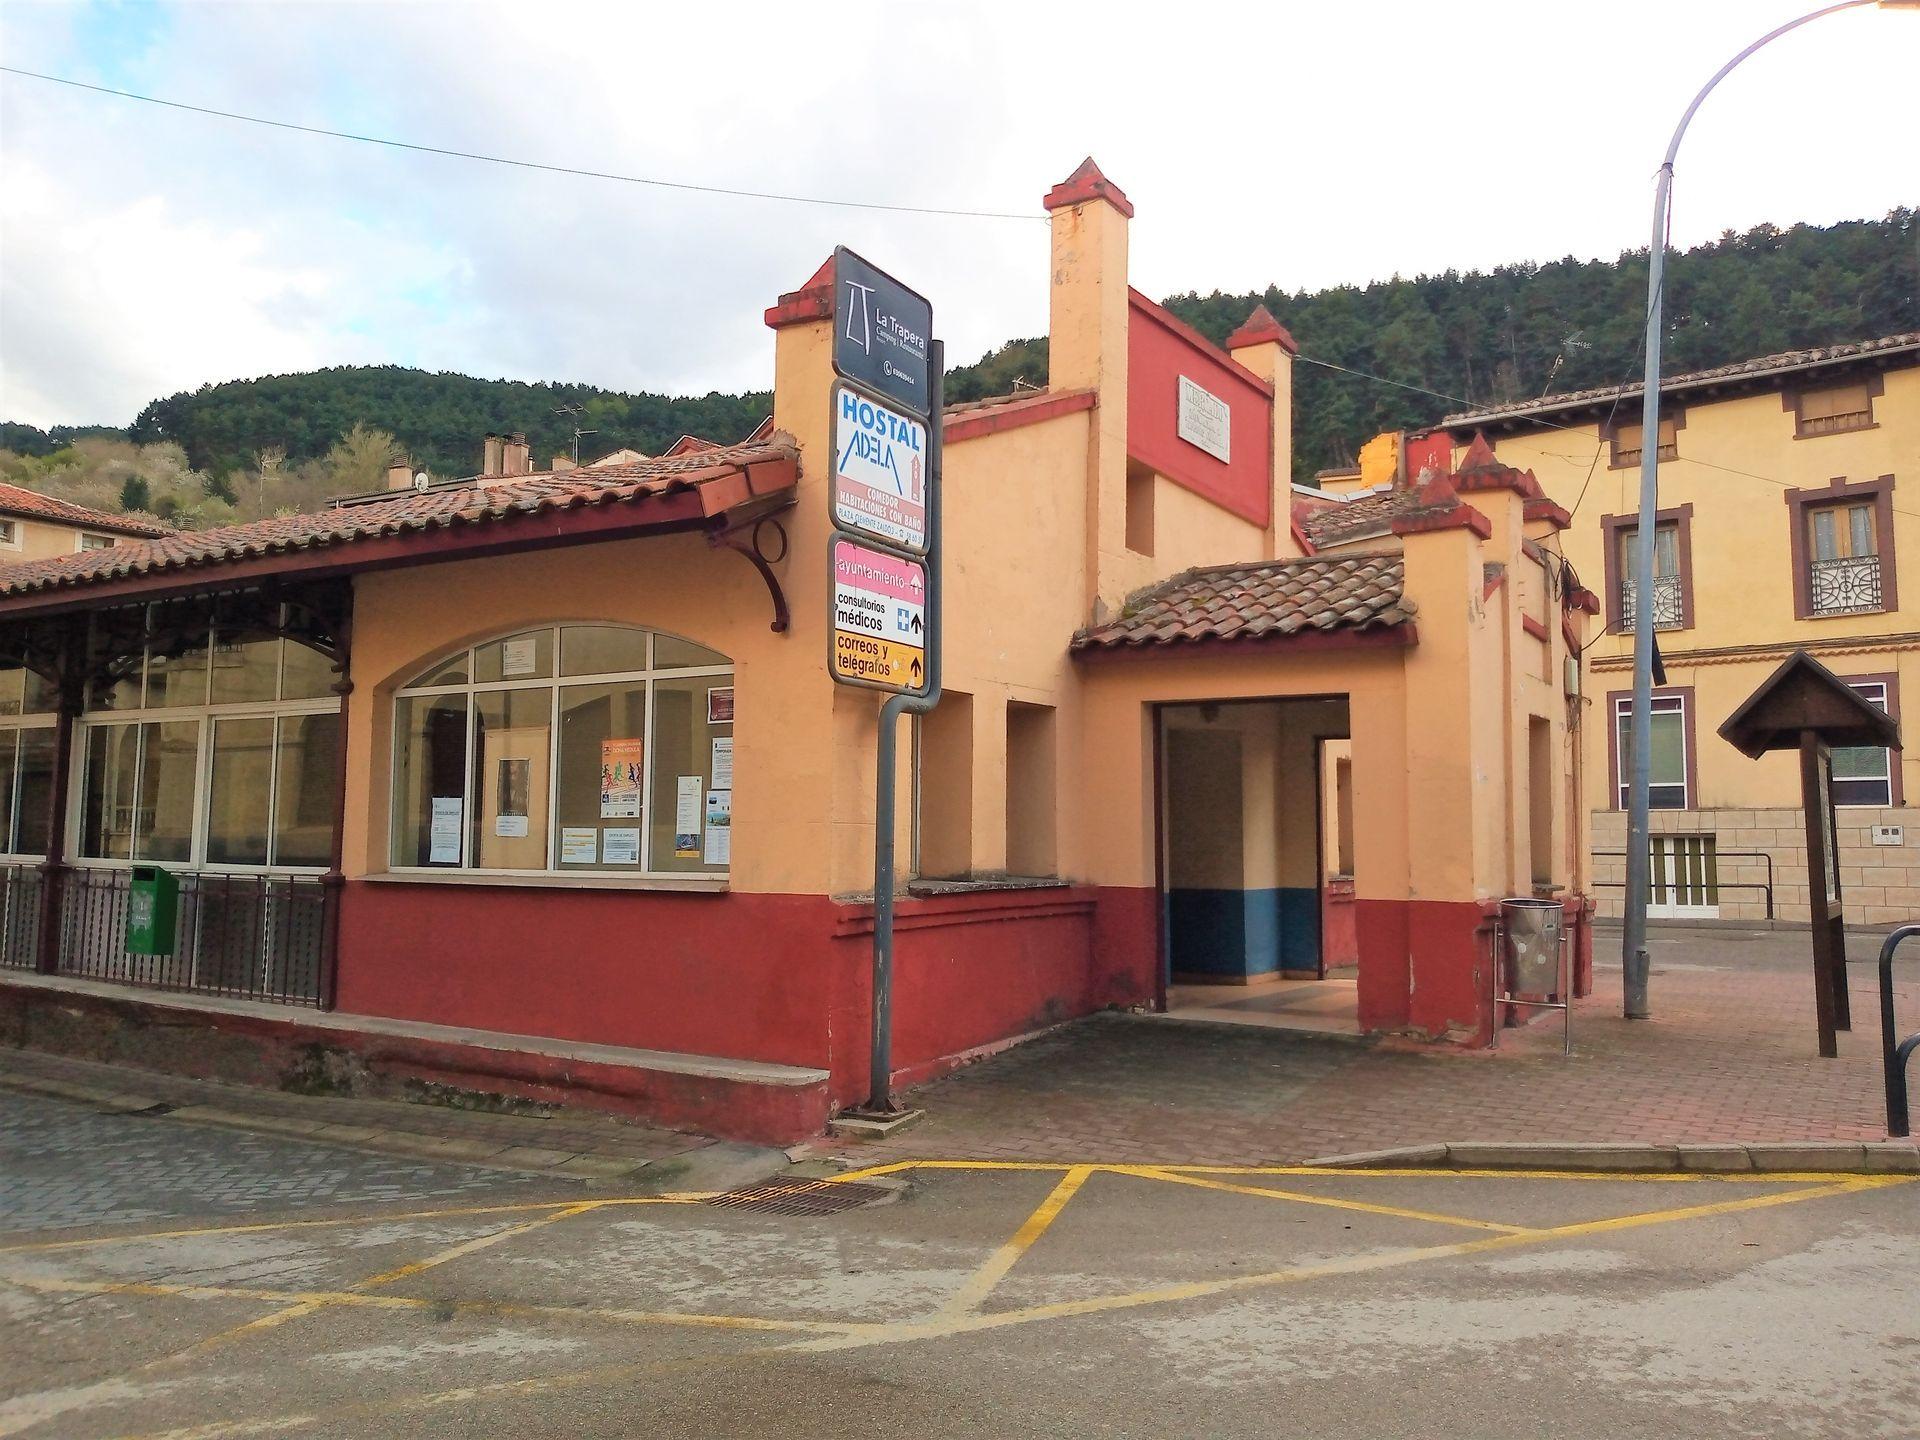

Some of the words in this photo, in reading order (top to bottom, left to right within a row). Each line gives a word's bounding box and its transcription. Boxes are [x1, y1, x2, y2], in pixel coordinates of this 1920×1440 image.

[876, 308, 887, 328] La
[889, 316, 924, 350] Trapera
[843, 394, 920, 453] HOSTAL
[839, 429, 903, 496] ADELA
[839, 490, 887, 518] HABITACIONES
[889, 509, 902, 524] CON
[904, 514, 922, 531] BAÑO
[867, 488, 899, 509] COMEDOR
[838, 507, 853, 520] PLAZA
[854, 513, 876, 529] CLEMENTE
[838, 558, 905, 589] ayuntamiento
[838, 593, 886, 614] consultorios
[838, 608, 883, 631] médicos
[838, 635, 879, 656] correos
[882, 645, 888, 660] y
[838, 652, 890, 677] telégrafos
